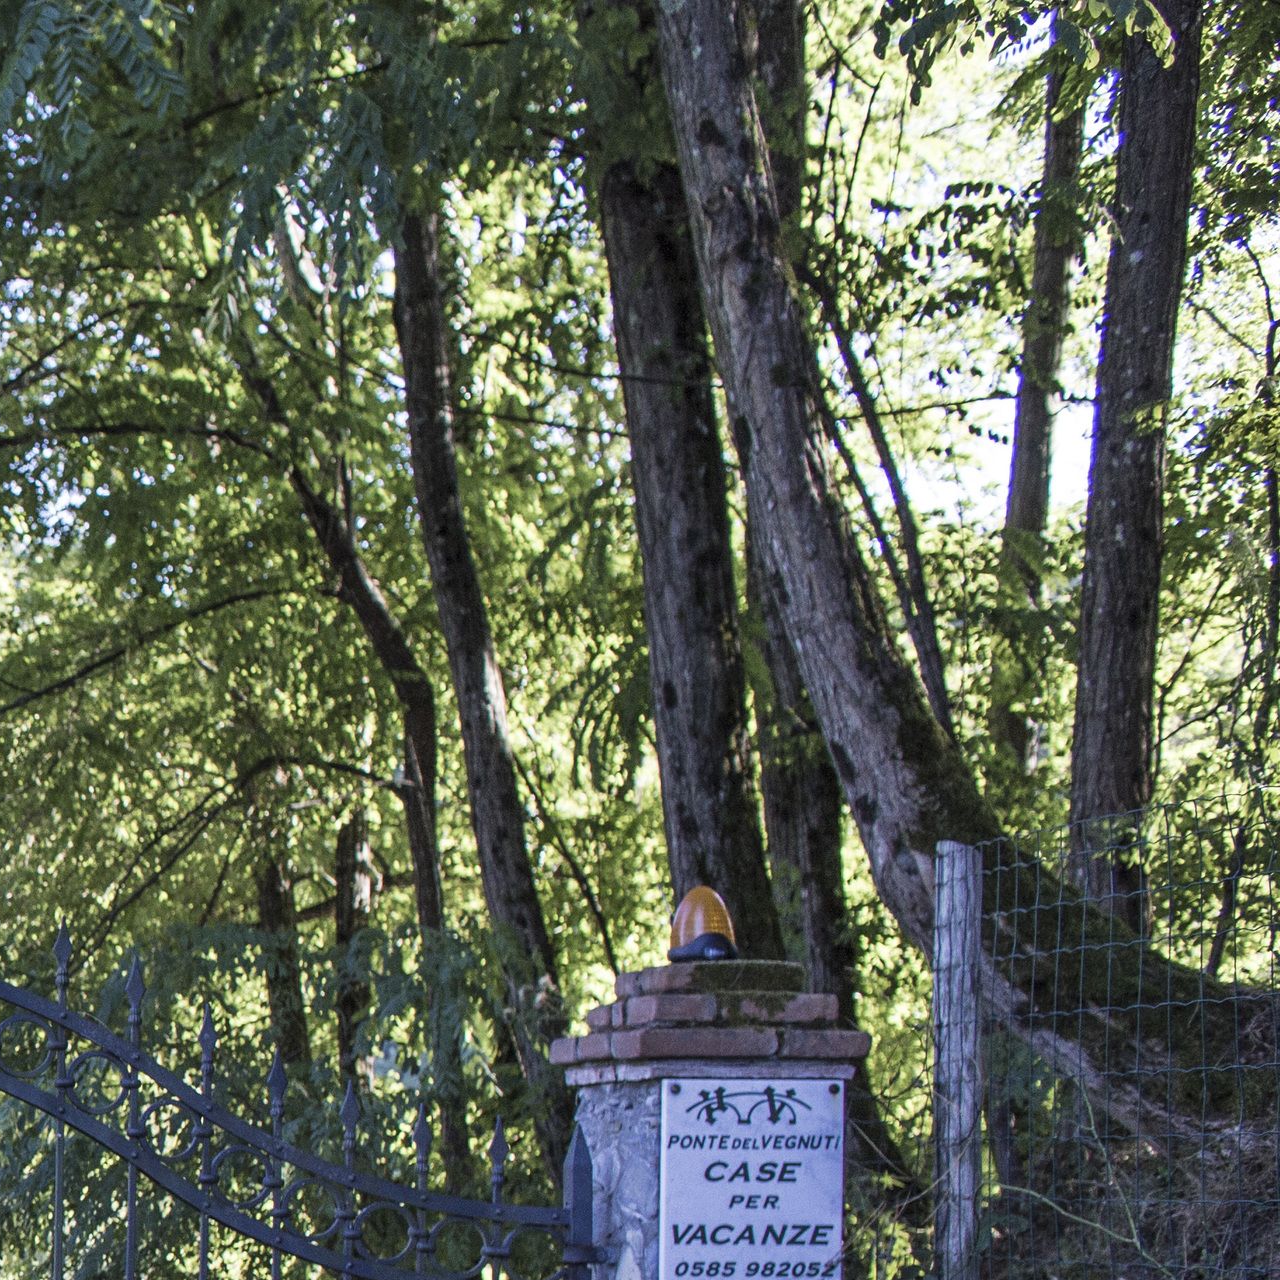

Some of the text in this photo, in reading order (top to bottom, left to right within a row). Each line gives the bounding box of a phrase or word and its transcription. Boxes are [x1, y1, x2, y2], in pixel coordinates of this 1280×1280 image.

[704, 1162, 801, 1183] CASE
[729, 1195, 779, 1209] PER
[672, 1224, 834, 1246] VACANZE
[675, 1262, 835, 1278] 0585 982052
